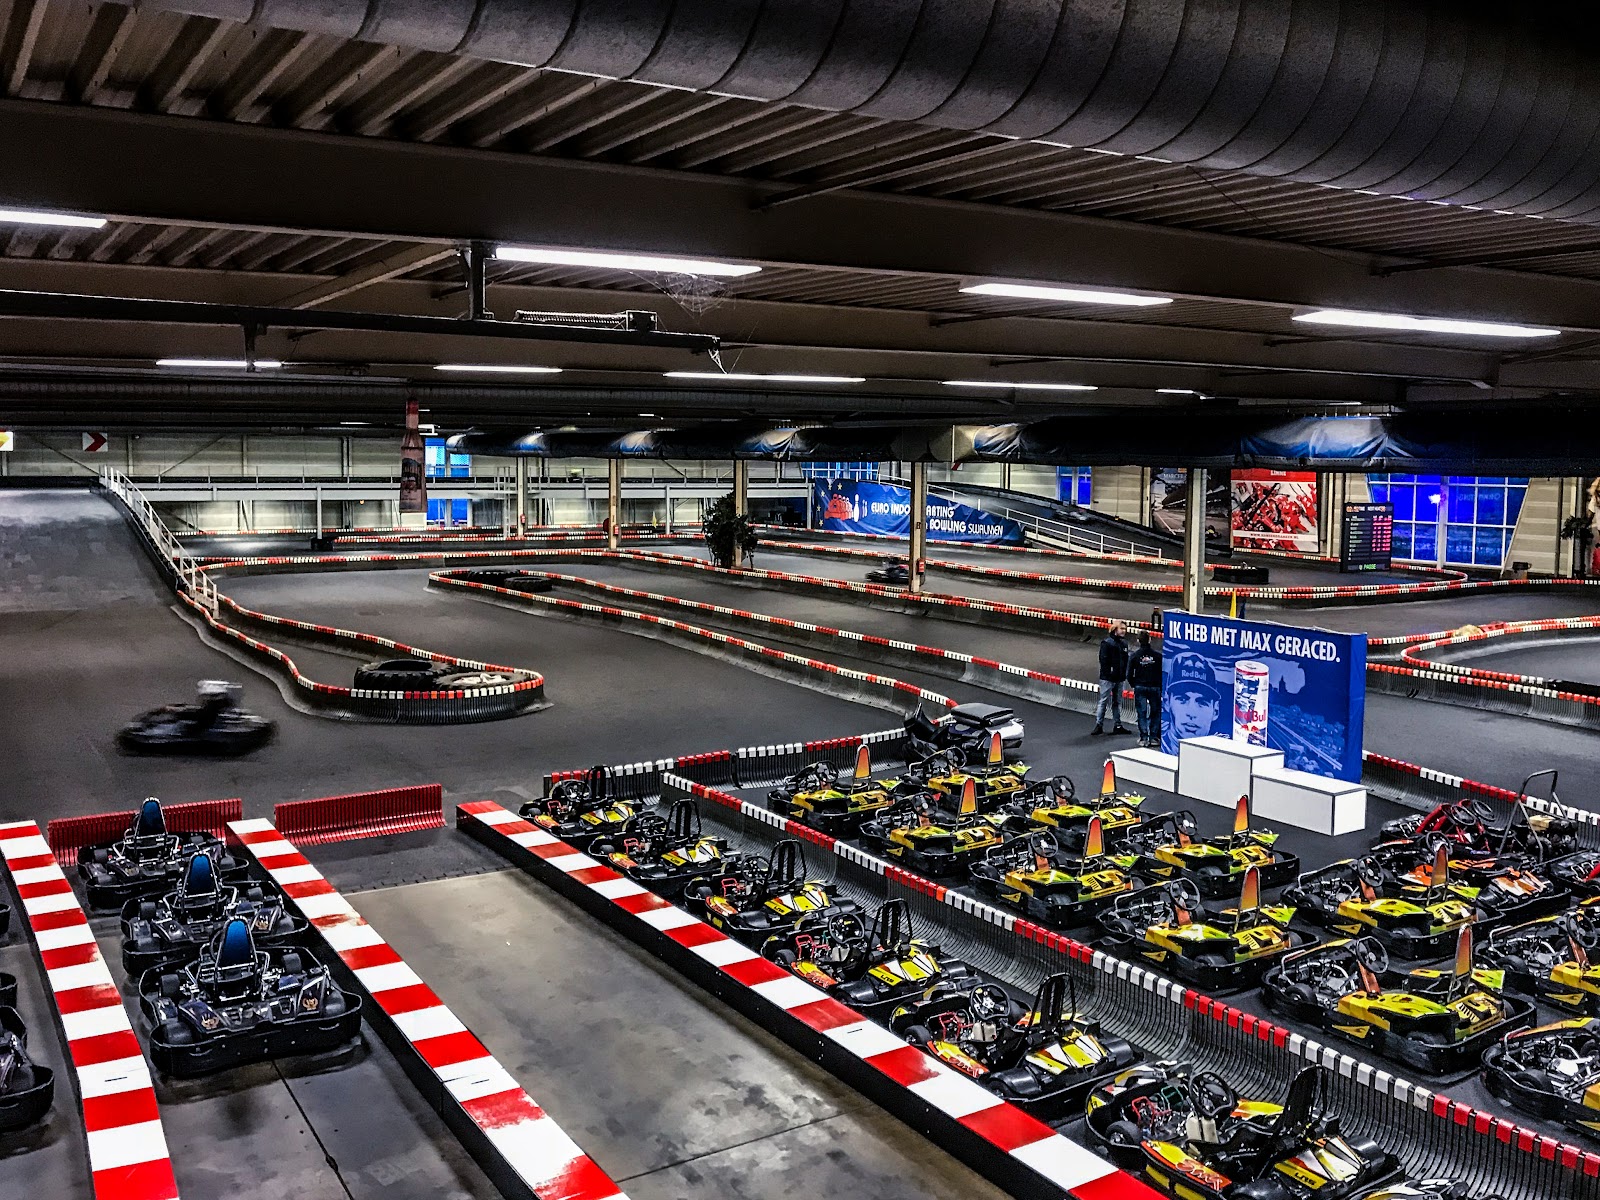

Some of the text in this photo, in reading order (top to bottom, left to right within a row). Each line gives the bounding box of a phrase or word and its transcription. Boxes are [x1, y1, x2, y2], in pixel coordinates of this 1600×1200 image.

[870, 502, 889, 513] EURO
[925, 505, 954, 518] ARTING
[929, 519, 966, 533] BOWLING
[968, 524, 1003, 536] SWALMEN
[1169, 620, 1341, 663] IK HEB MET MAX GERACED.
[1181, 669, 1207, 681] Red Bull
